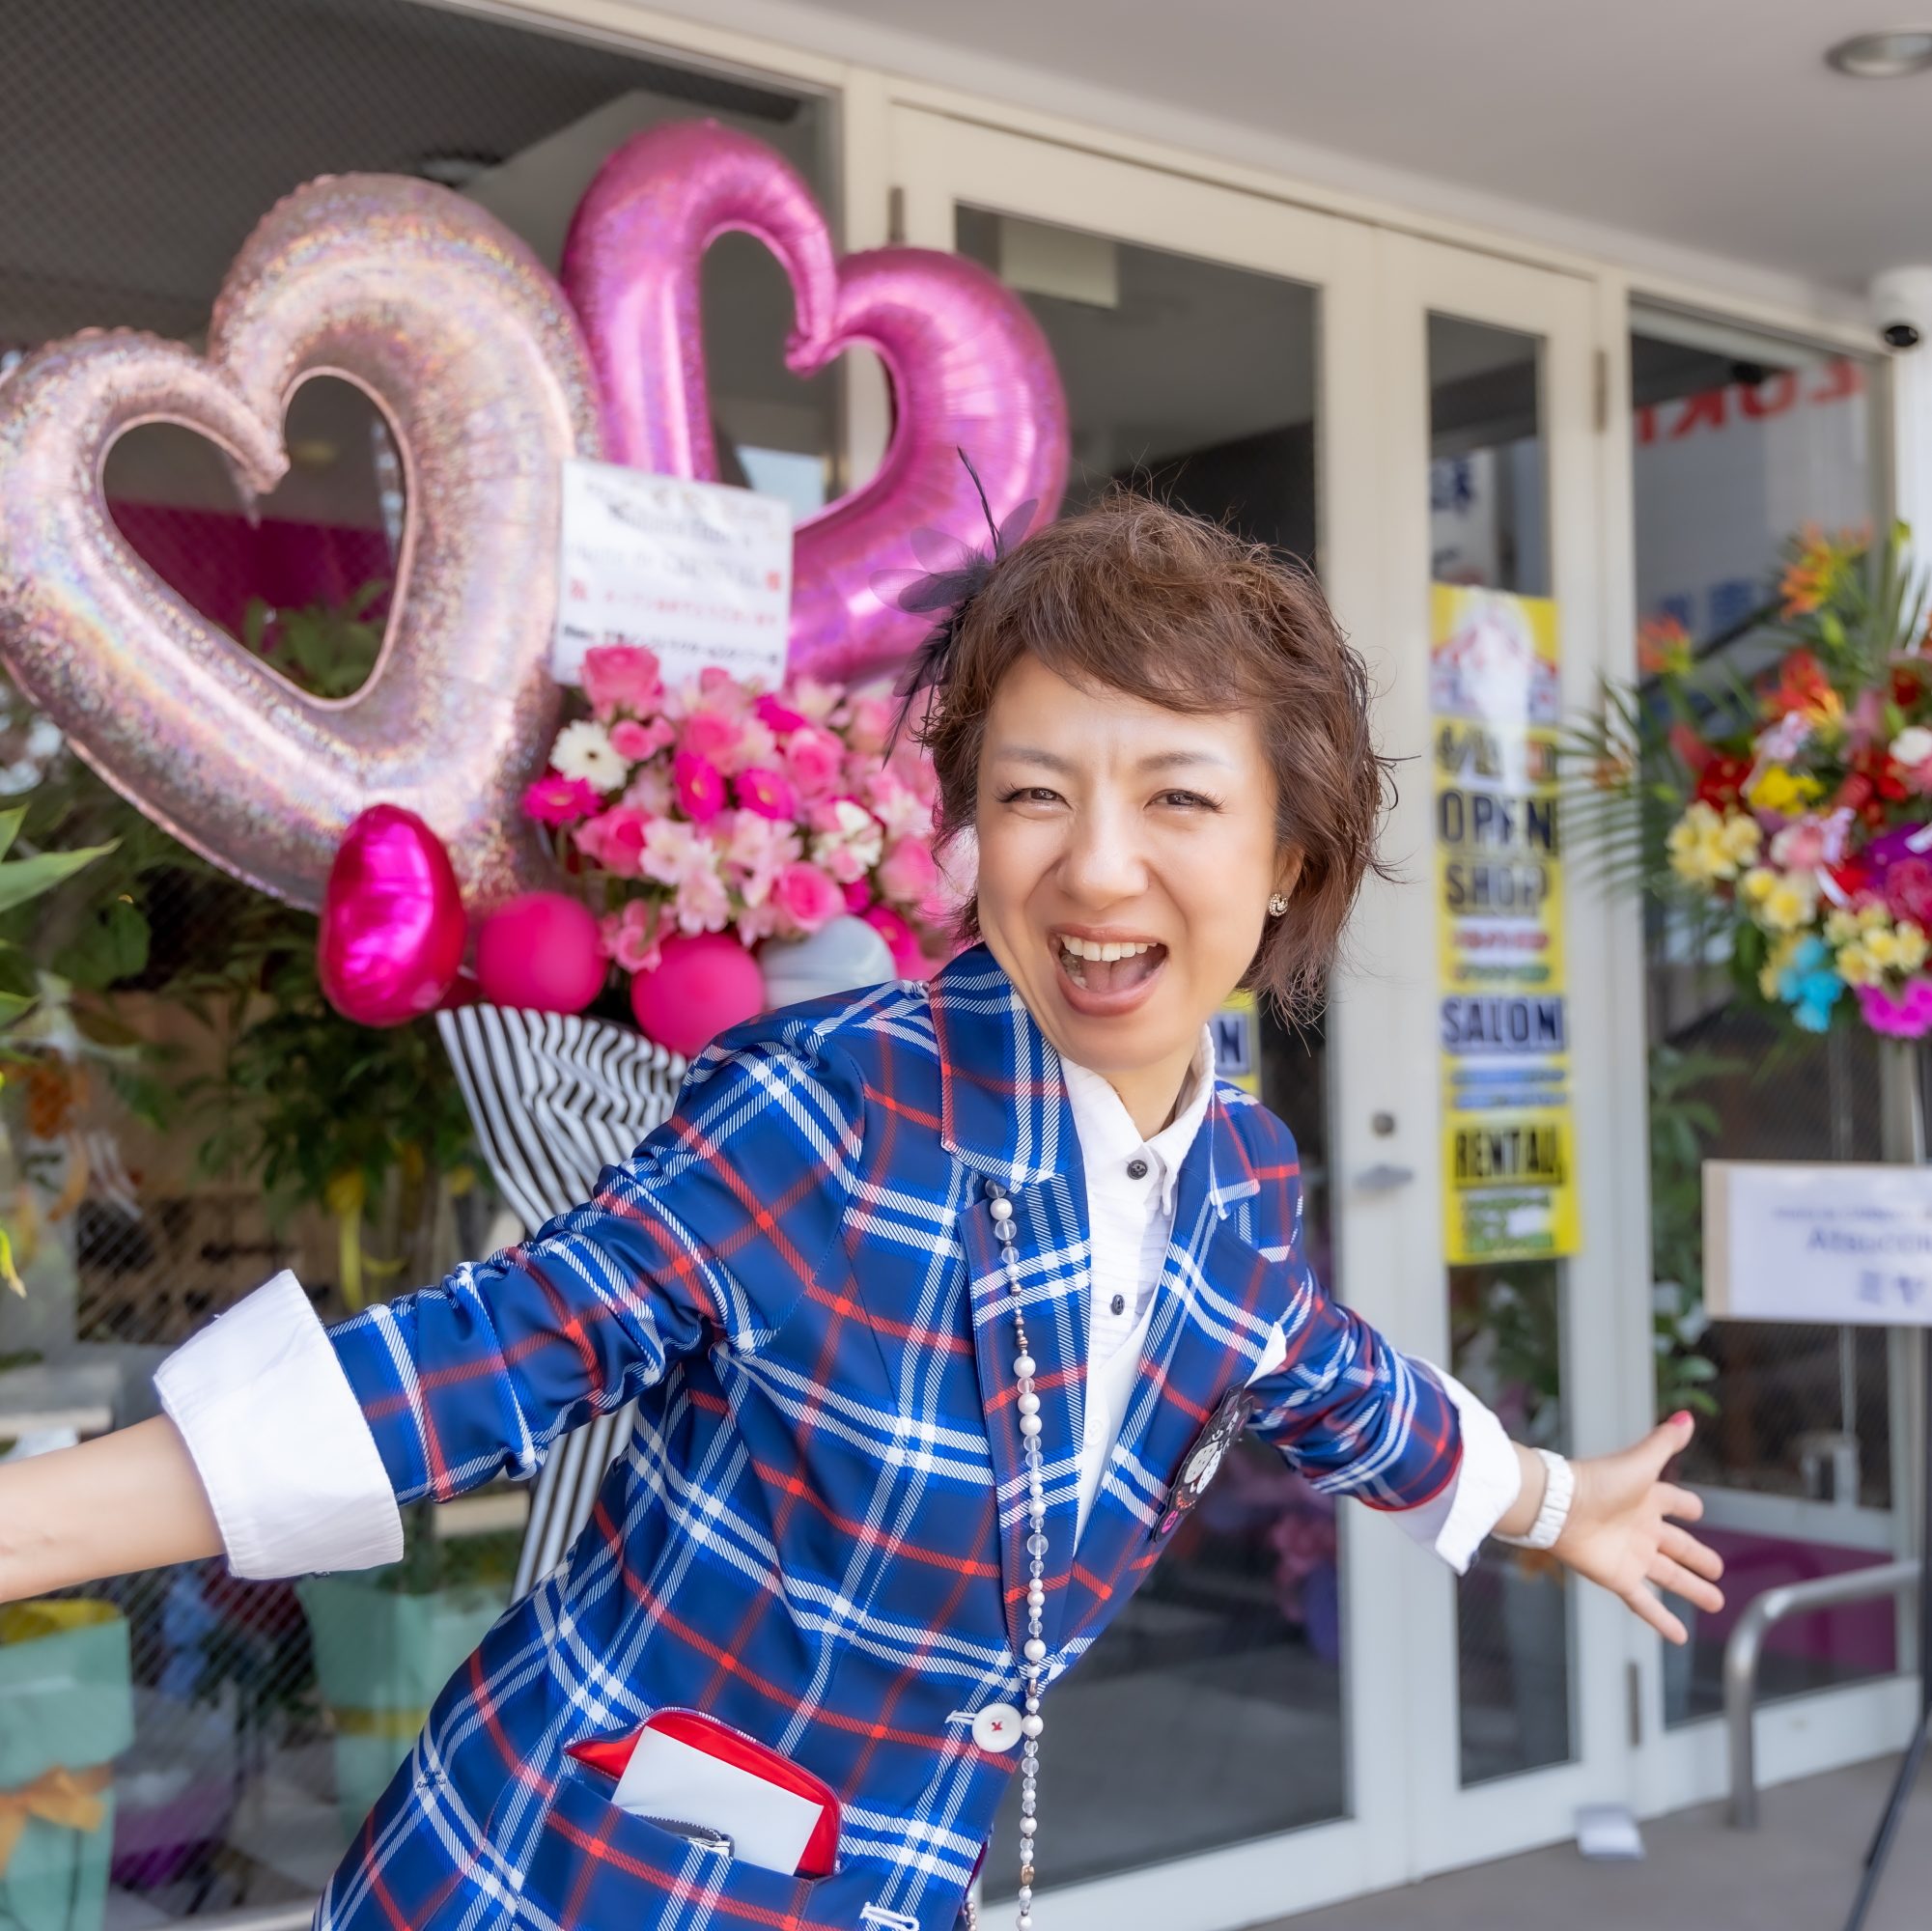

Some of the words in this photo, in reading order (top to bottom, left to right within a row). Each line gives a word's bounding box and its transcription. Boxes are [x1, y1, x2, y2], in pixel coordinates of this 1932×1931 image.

[1443, 863, 1552, 910] SHOP
[1441, 996, 1562, 1046] SALON
[1455, 1126, 1562, 1184] RENTAL
